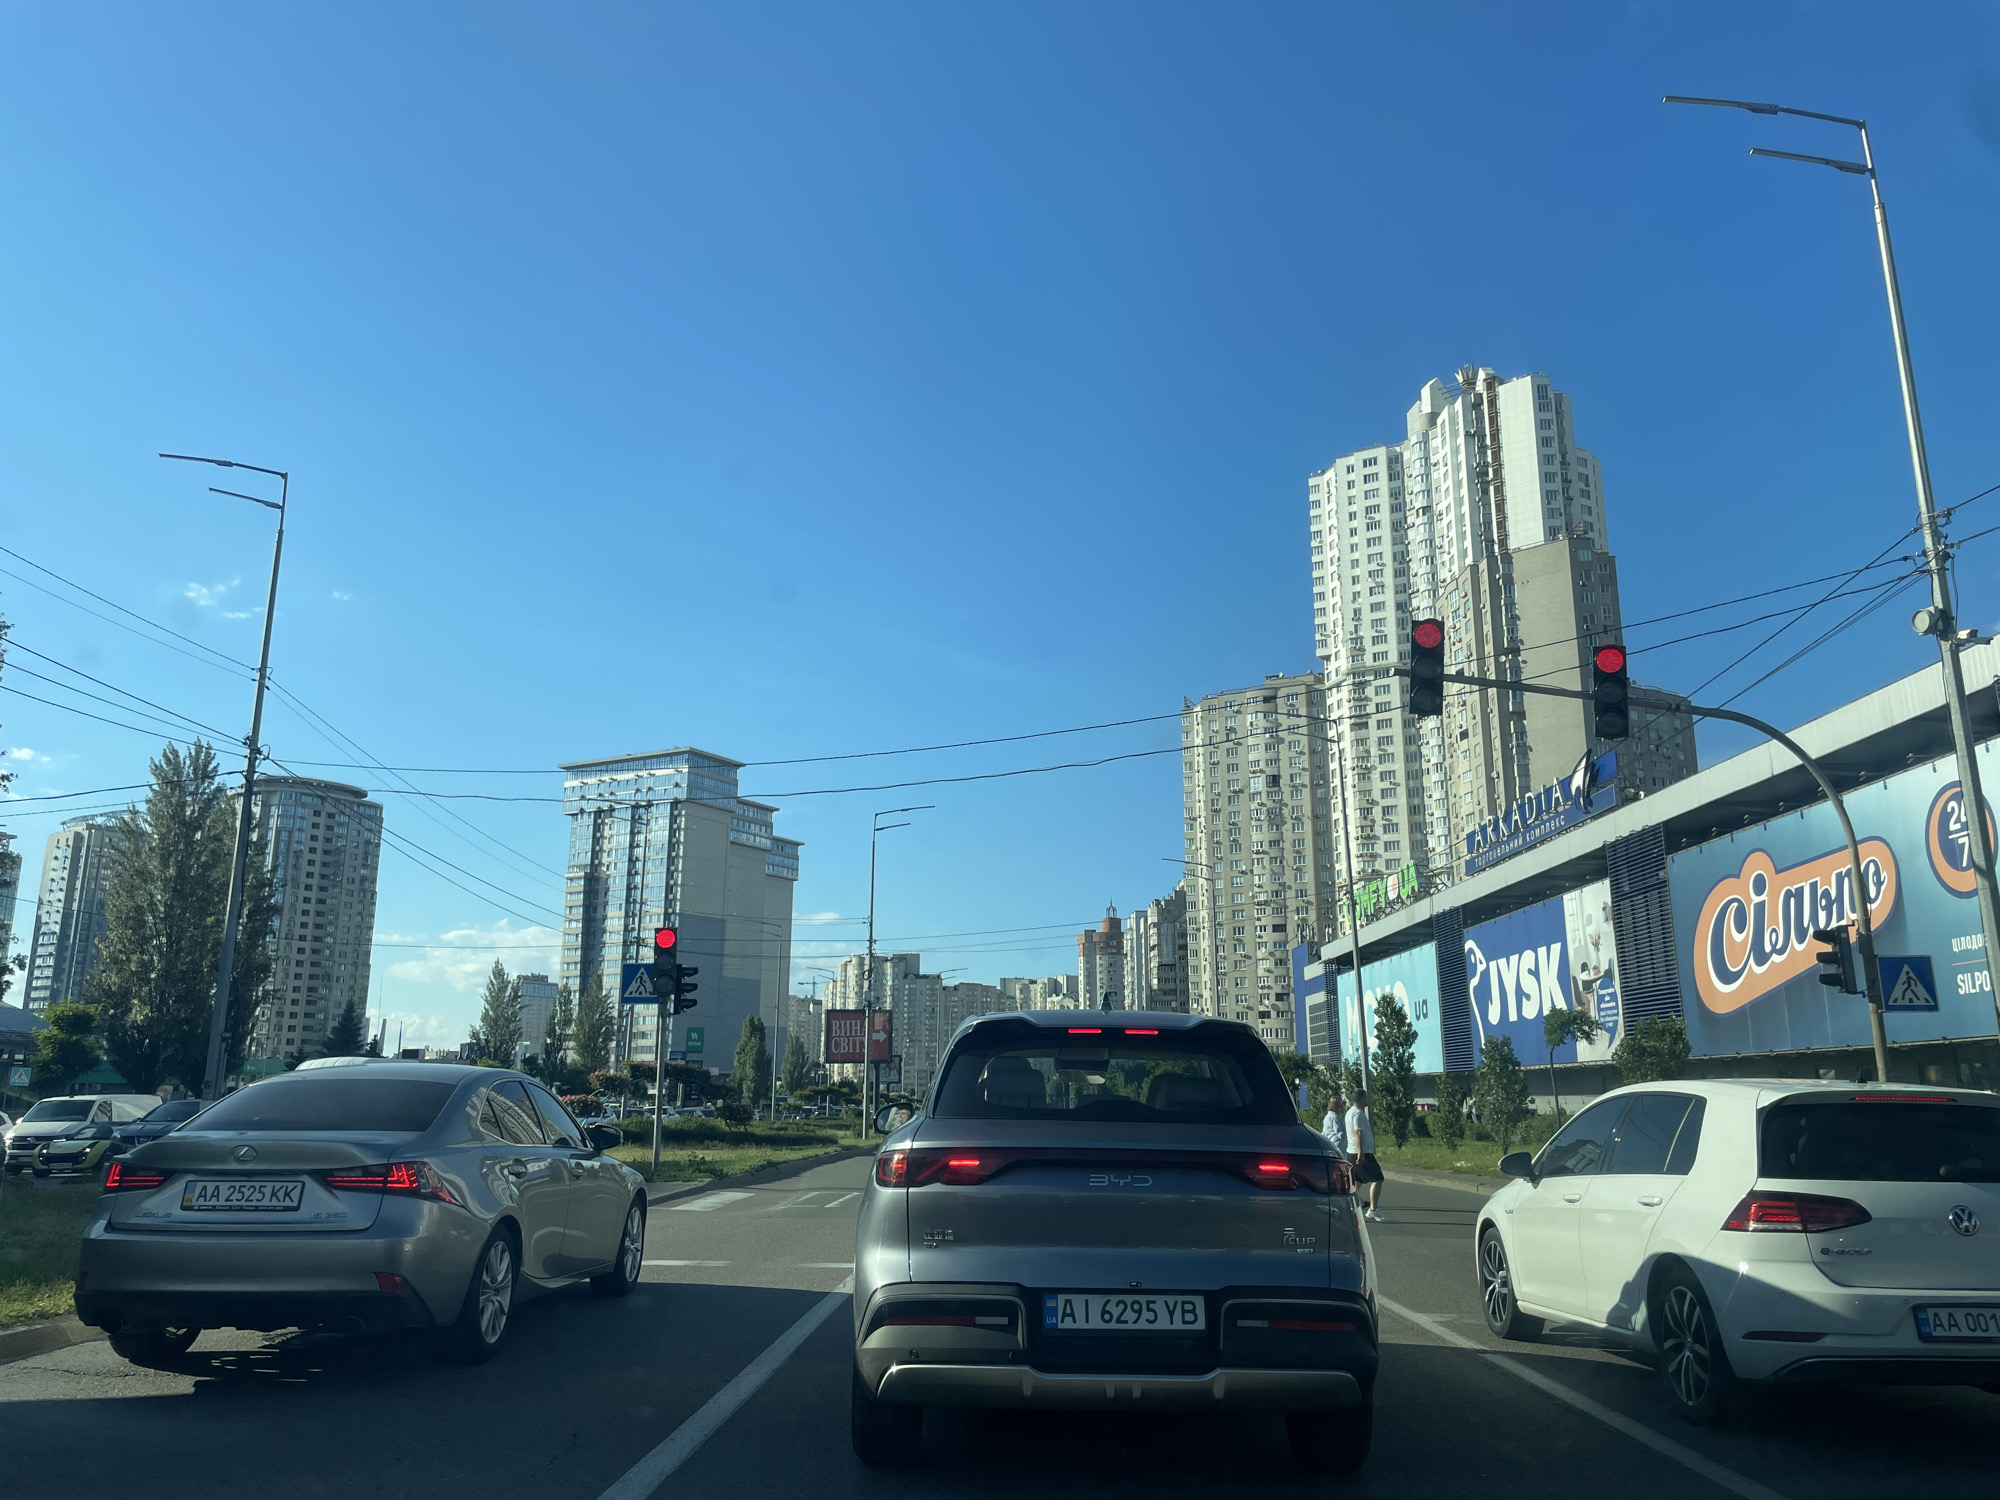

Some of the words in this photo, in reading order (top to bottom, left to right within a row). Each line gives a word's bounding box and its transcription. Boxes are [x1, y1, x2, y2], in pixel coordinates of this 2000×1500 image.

[1474, 777, 1564, 853] ARKADIA
[1474, 833, 1523, 868] торговельний
[1526, 814, 1565, 843] комплекс
[1957, 835, 1970, 868] 7
[1708, 857, 1887, 991] Сільпо
[1951, 933, 1985, 953] ЦІЛОДО
[1488, 942, 1568, 1026] JYSK
[1345, 980, 1411, 1056] MOO
[196, 1184, 220, 1203] AA
[224, 1184, 266, 1203] 2525
[269, 1184, 298, 1203] KK
[1089, 1174, 1153, 1187] BYD
[1046, 1316, 1057, 1324] UA
[1060, 1298, 1089, 1324] AI
[1100, 1299, 1159, 1325] 6295
[1163, 1300, 1199, 1325] YB
[1932, 1312, 1962, 1333] AA
